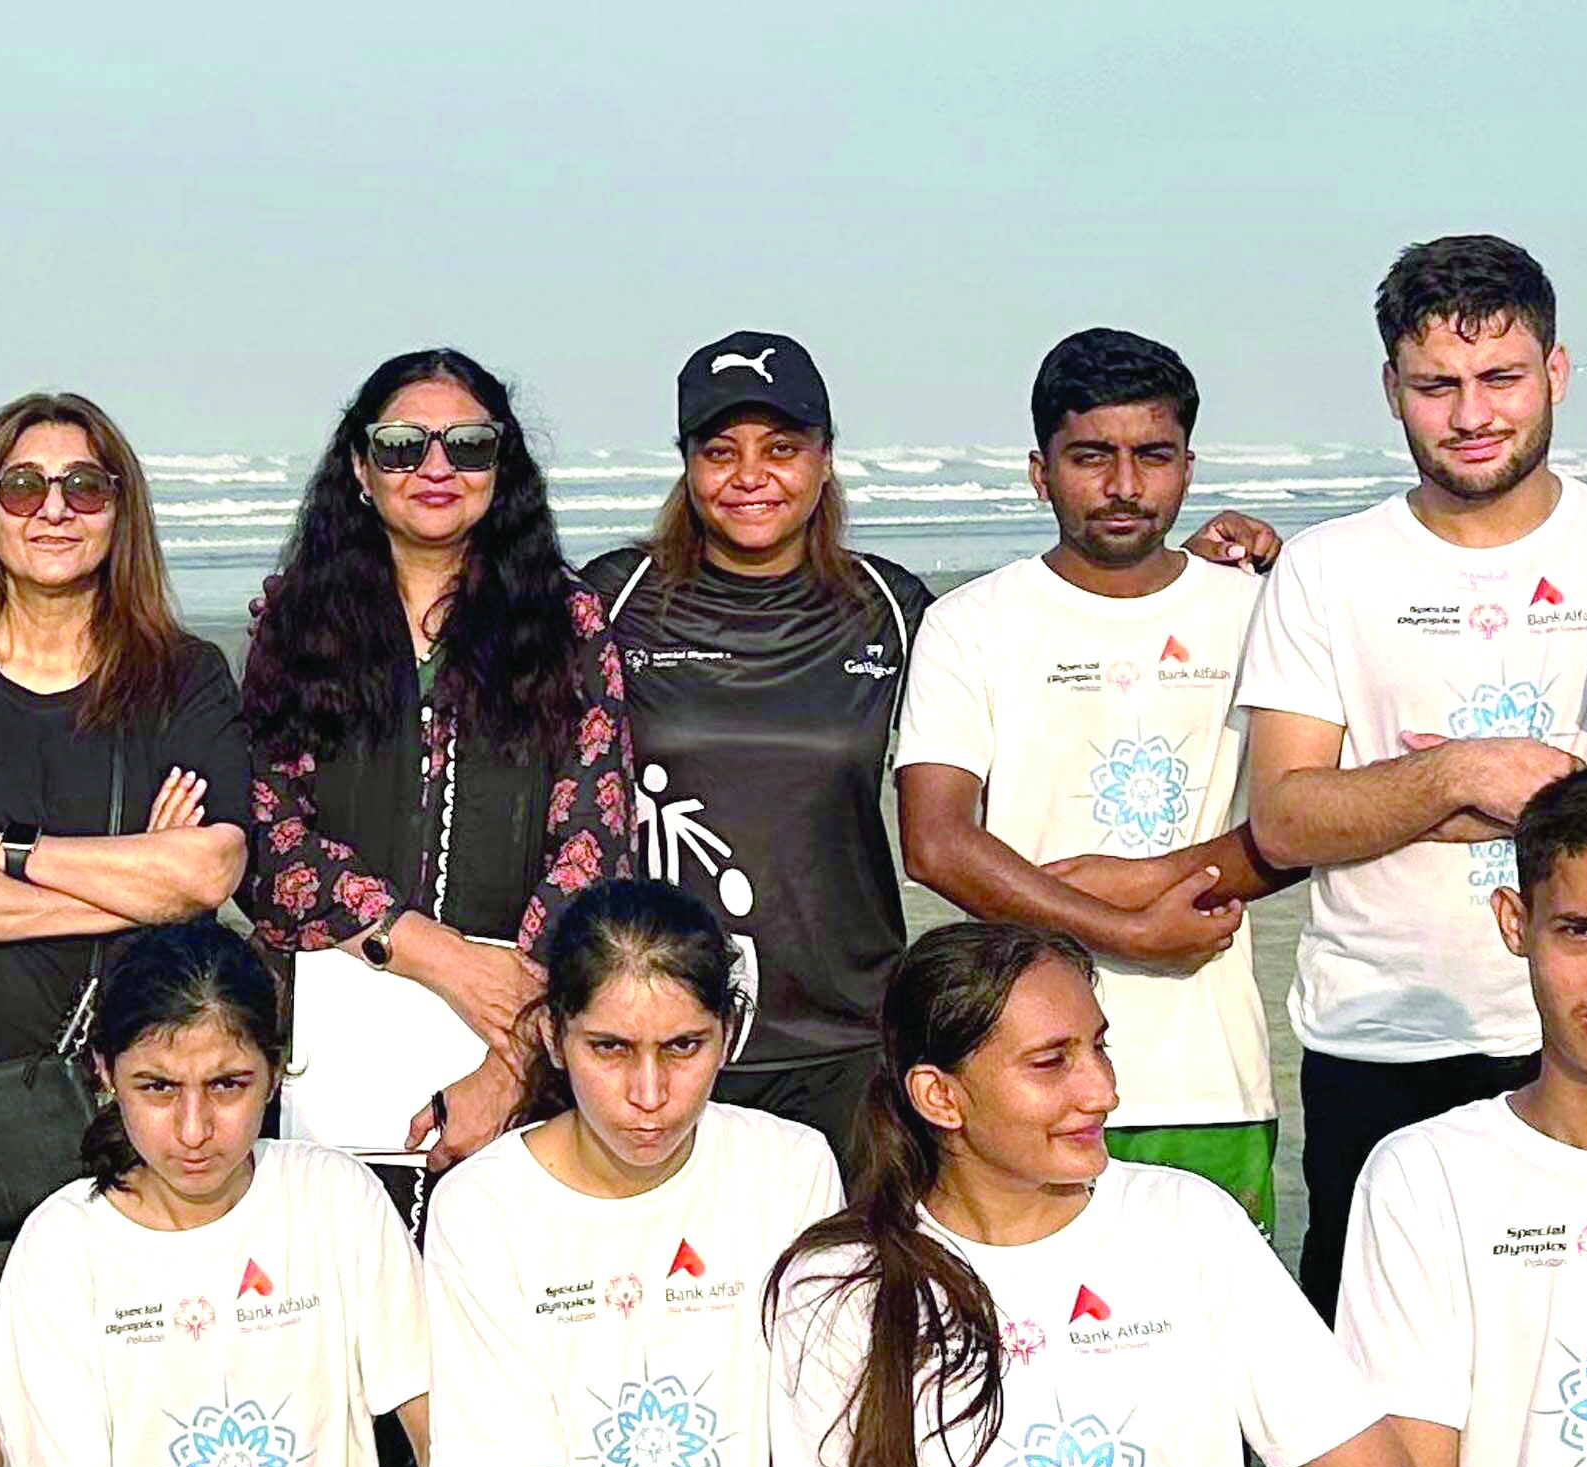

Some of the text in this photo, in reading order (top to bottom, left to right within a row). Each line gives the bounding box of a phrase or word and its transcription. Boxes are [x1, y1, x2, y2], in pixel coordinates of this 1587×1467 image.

[1505, 1224, 1567, 1239] Special
[665, 1286, 704, 1303] Bank
[236, 1304, 274, 1323] Bank
[1069, 1329, 1110, 1345] Bank
